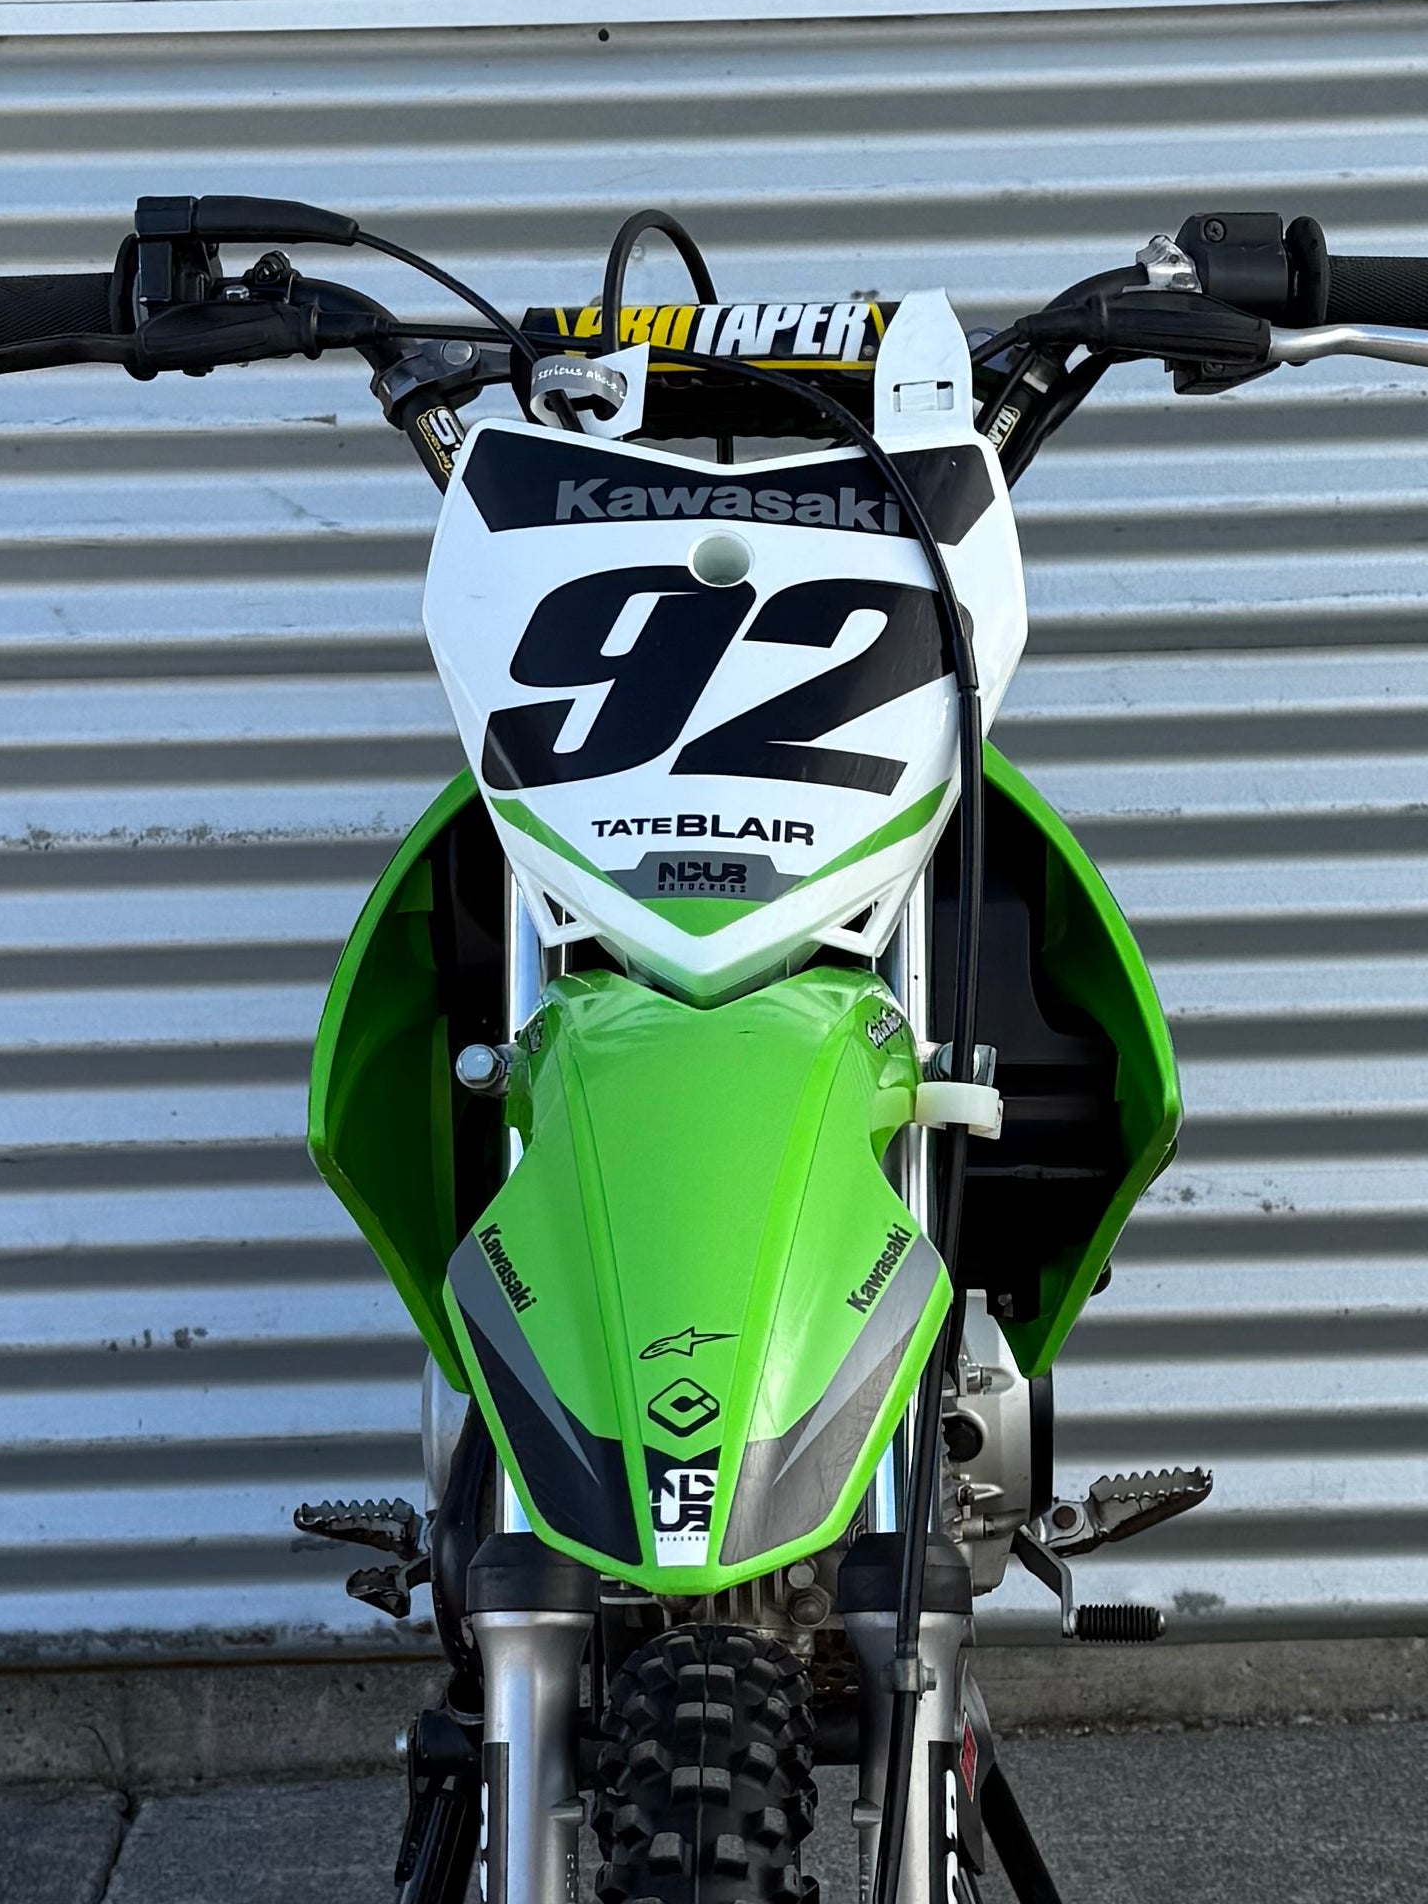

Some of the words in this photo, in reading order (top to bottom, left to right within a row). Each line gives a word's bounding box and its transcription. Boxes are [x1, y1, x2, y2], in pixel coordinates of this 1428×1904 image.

[555, 478, 900, 533] Kawasaki
[482, 565, 974, 796] 92
[478, 1222, 537, 1314] Kawasaki
[846, 1222, 913, 1314] Kawasaki
